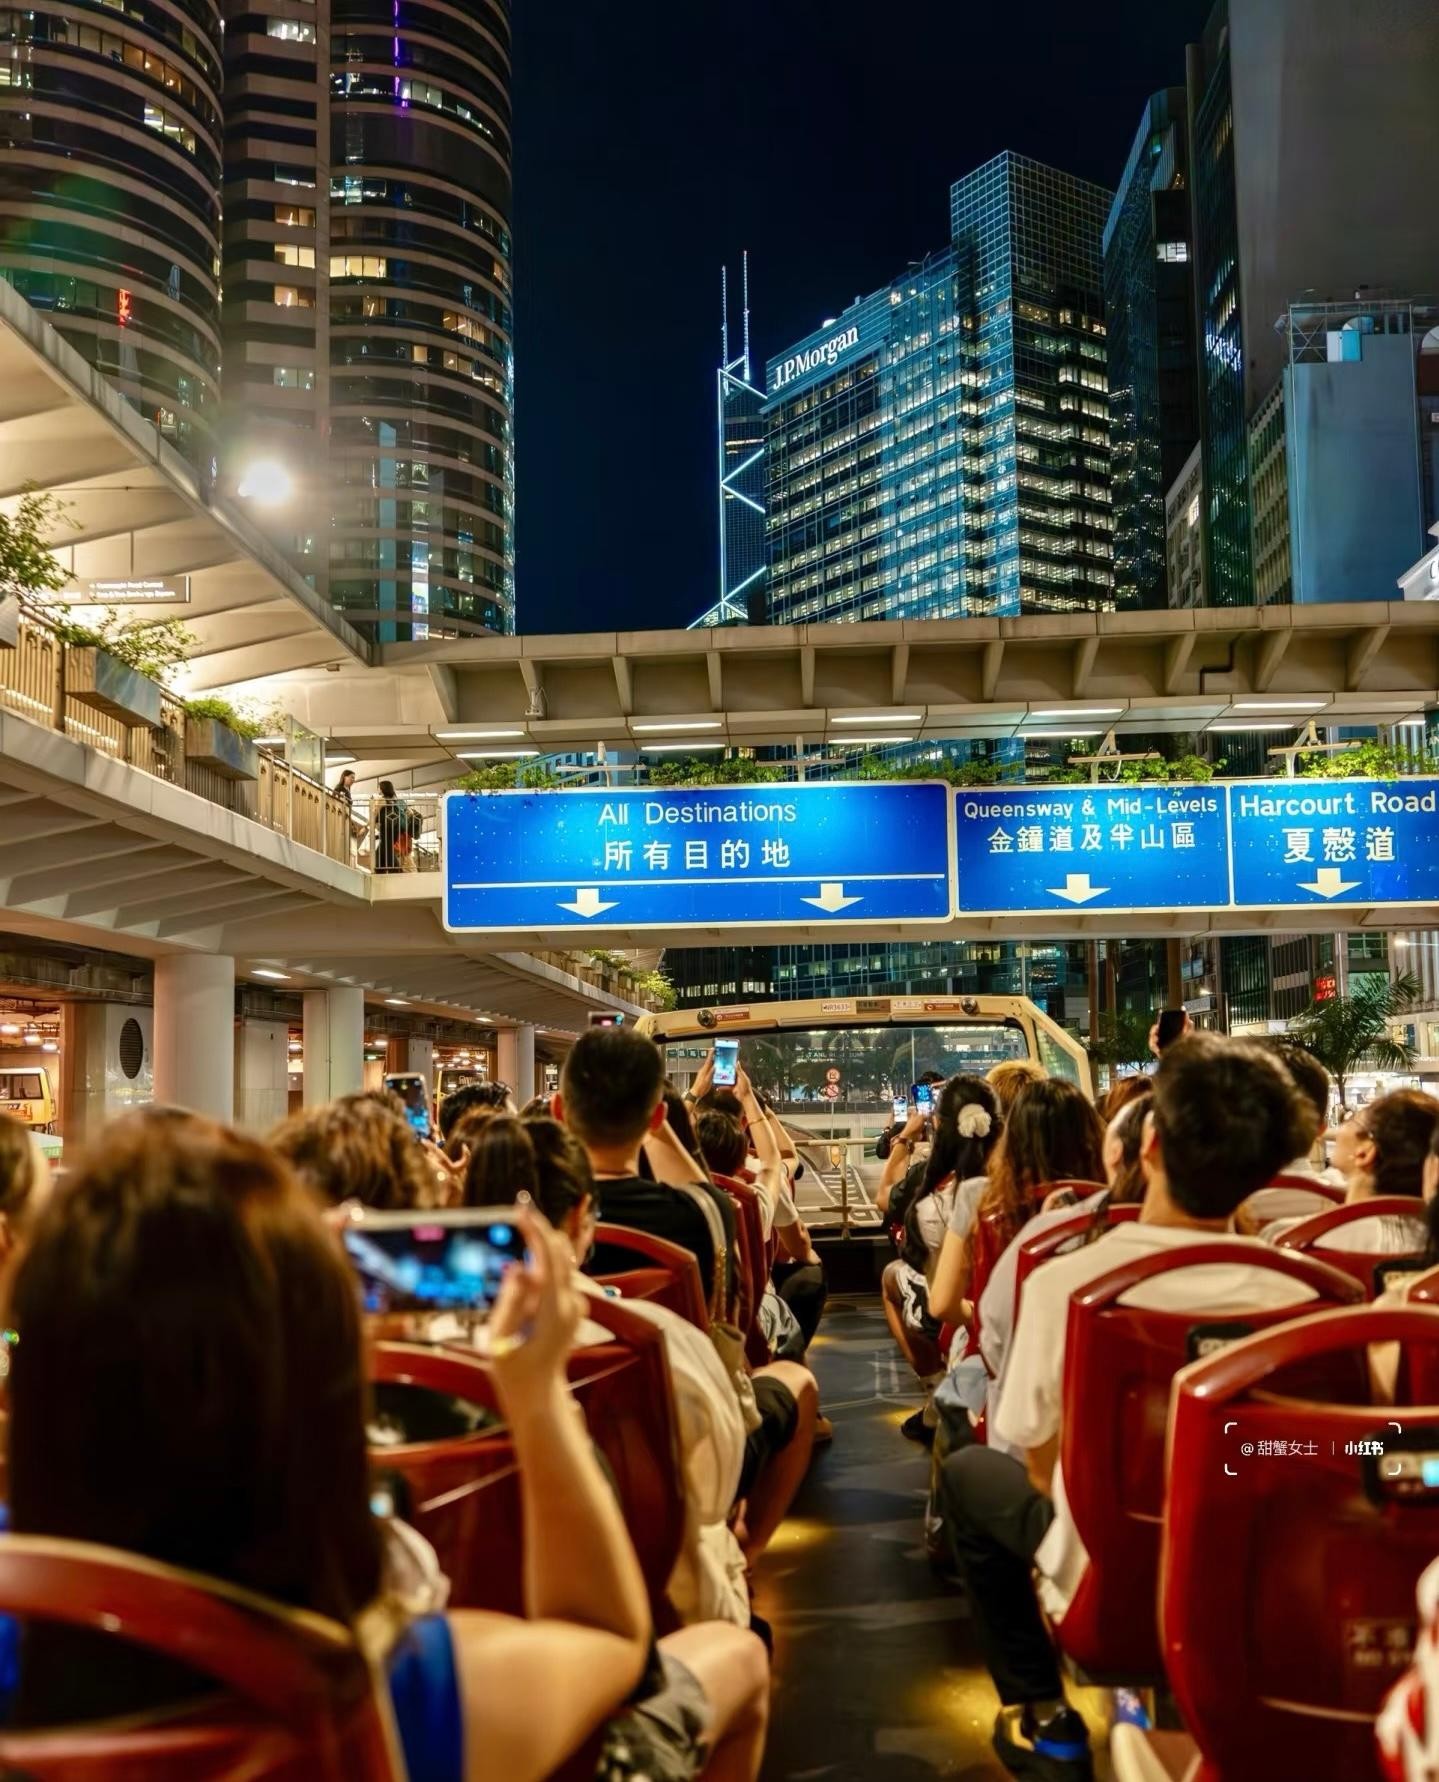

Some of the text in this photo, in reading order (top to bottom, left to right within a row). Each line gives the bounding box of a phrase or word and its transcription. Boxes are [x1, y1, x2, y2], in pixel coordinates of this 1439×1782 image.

[599, 801, 797, 825] All Destinations
[964, 796, 1218, 819] Queensway & Mid-Levels
[1240, 789, 1436, 817] Harcourt Road
[987, 822, 1196, 854] 金鐘道及半山區
[603, 838, 791, 871] 所有目的地
